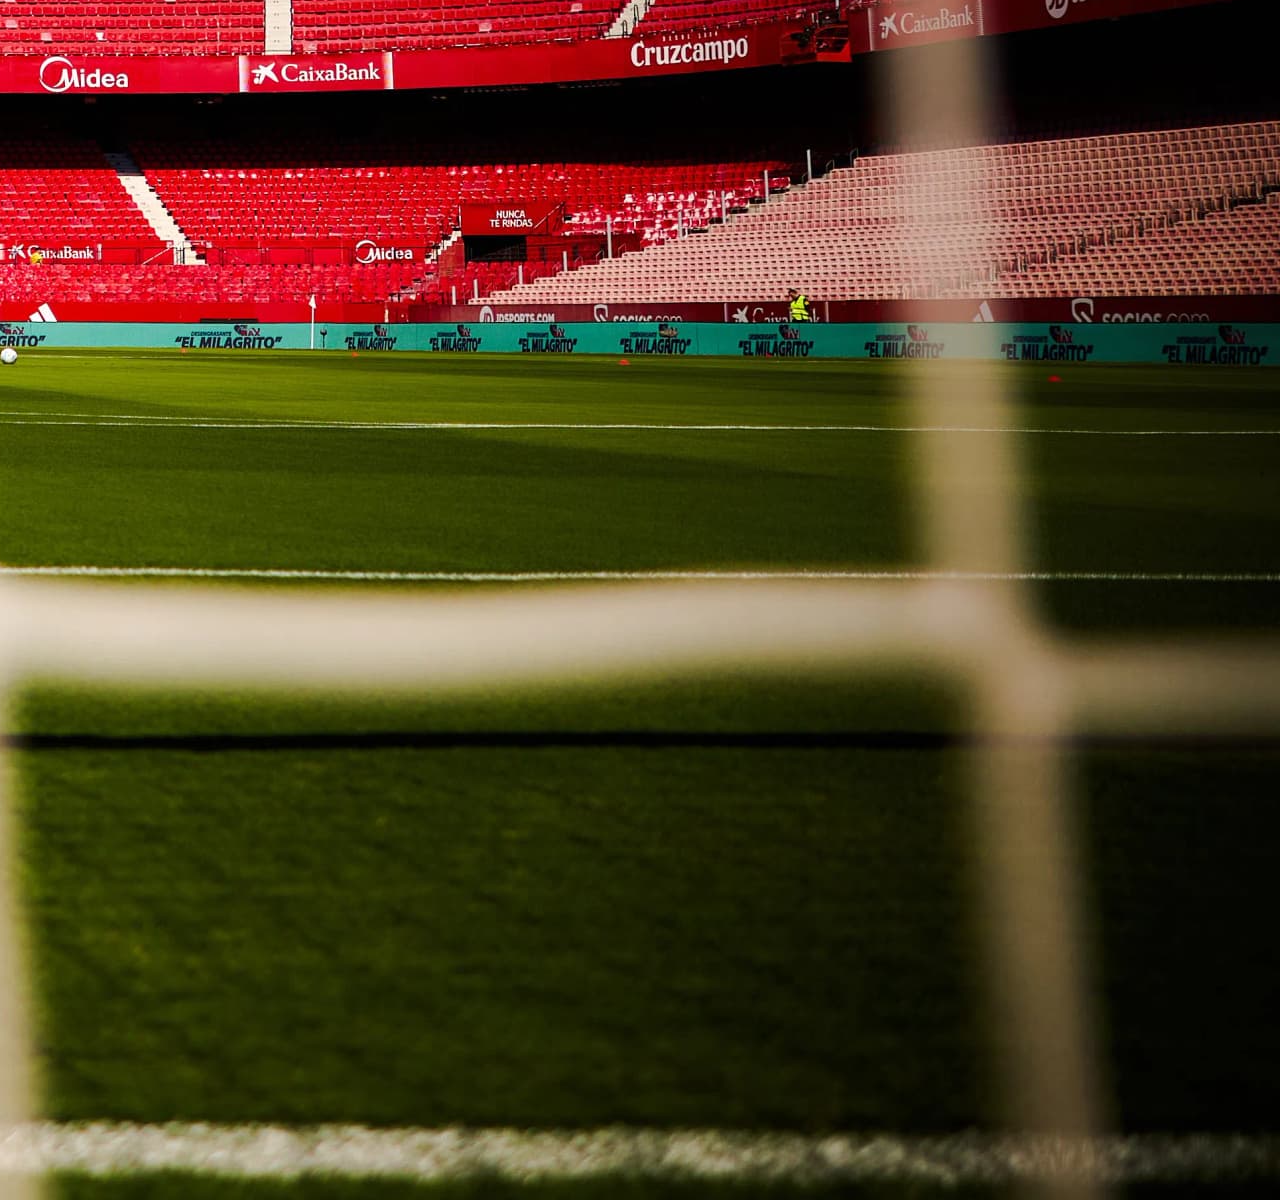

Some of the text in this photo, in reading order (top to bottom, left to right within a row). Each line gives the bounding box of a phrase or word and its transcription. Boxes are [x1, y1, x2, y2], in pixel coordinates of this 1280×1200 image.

[901, 4, 975, 34] CaixaBank
[630, 37, 749, 67] Cruzcampo
[46, 62, 129, 90] Midea
[281, 62, 381, 82] CaixaBank
[490, 218, 501, 228] TE
[496, 210, 526, 219] NUNCA
[361, 243, 413, 262] Midea
